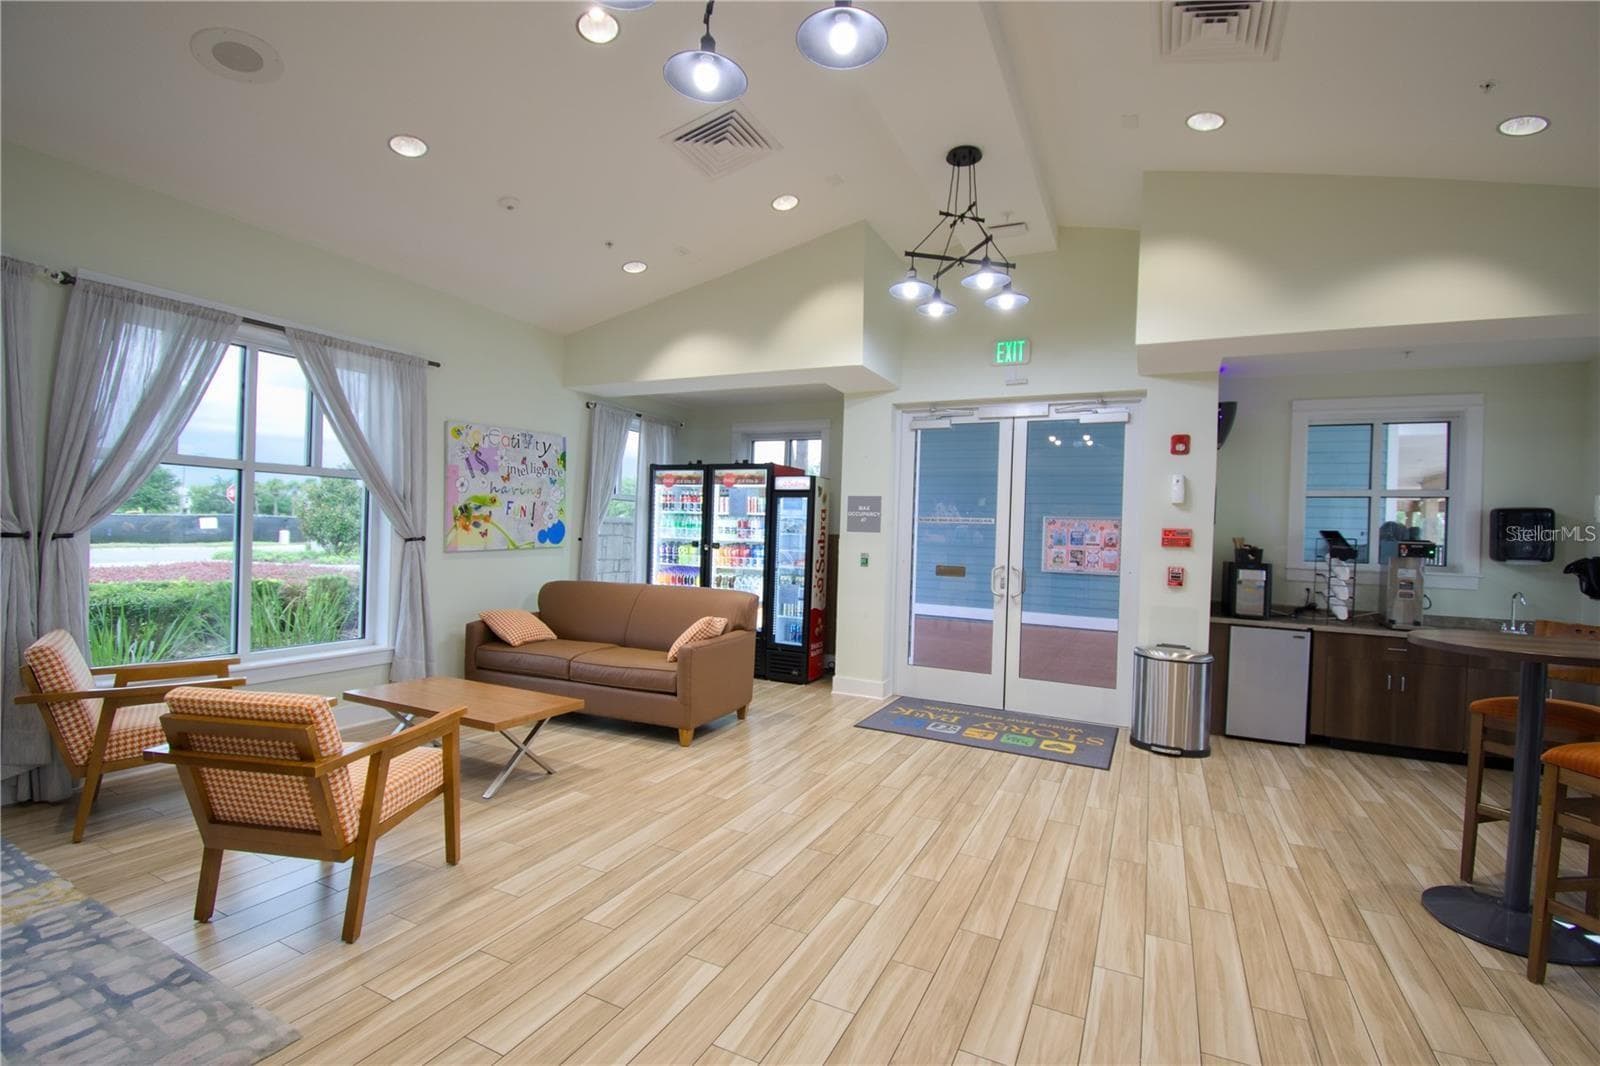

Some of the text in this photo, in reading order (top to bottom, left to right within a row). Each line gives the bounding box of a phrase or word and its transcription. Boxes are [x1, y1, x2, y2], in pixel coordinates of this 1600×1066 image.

[996, 340, 1025, 363] EXIT
[506, 462, 564, 478] intelligence
[489, 481, 543, 499] having
[816, 507, 827, 572] Sabra
[890, 706, 961, 724] PARK
